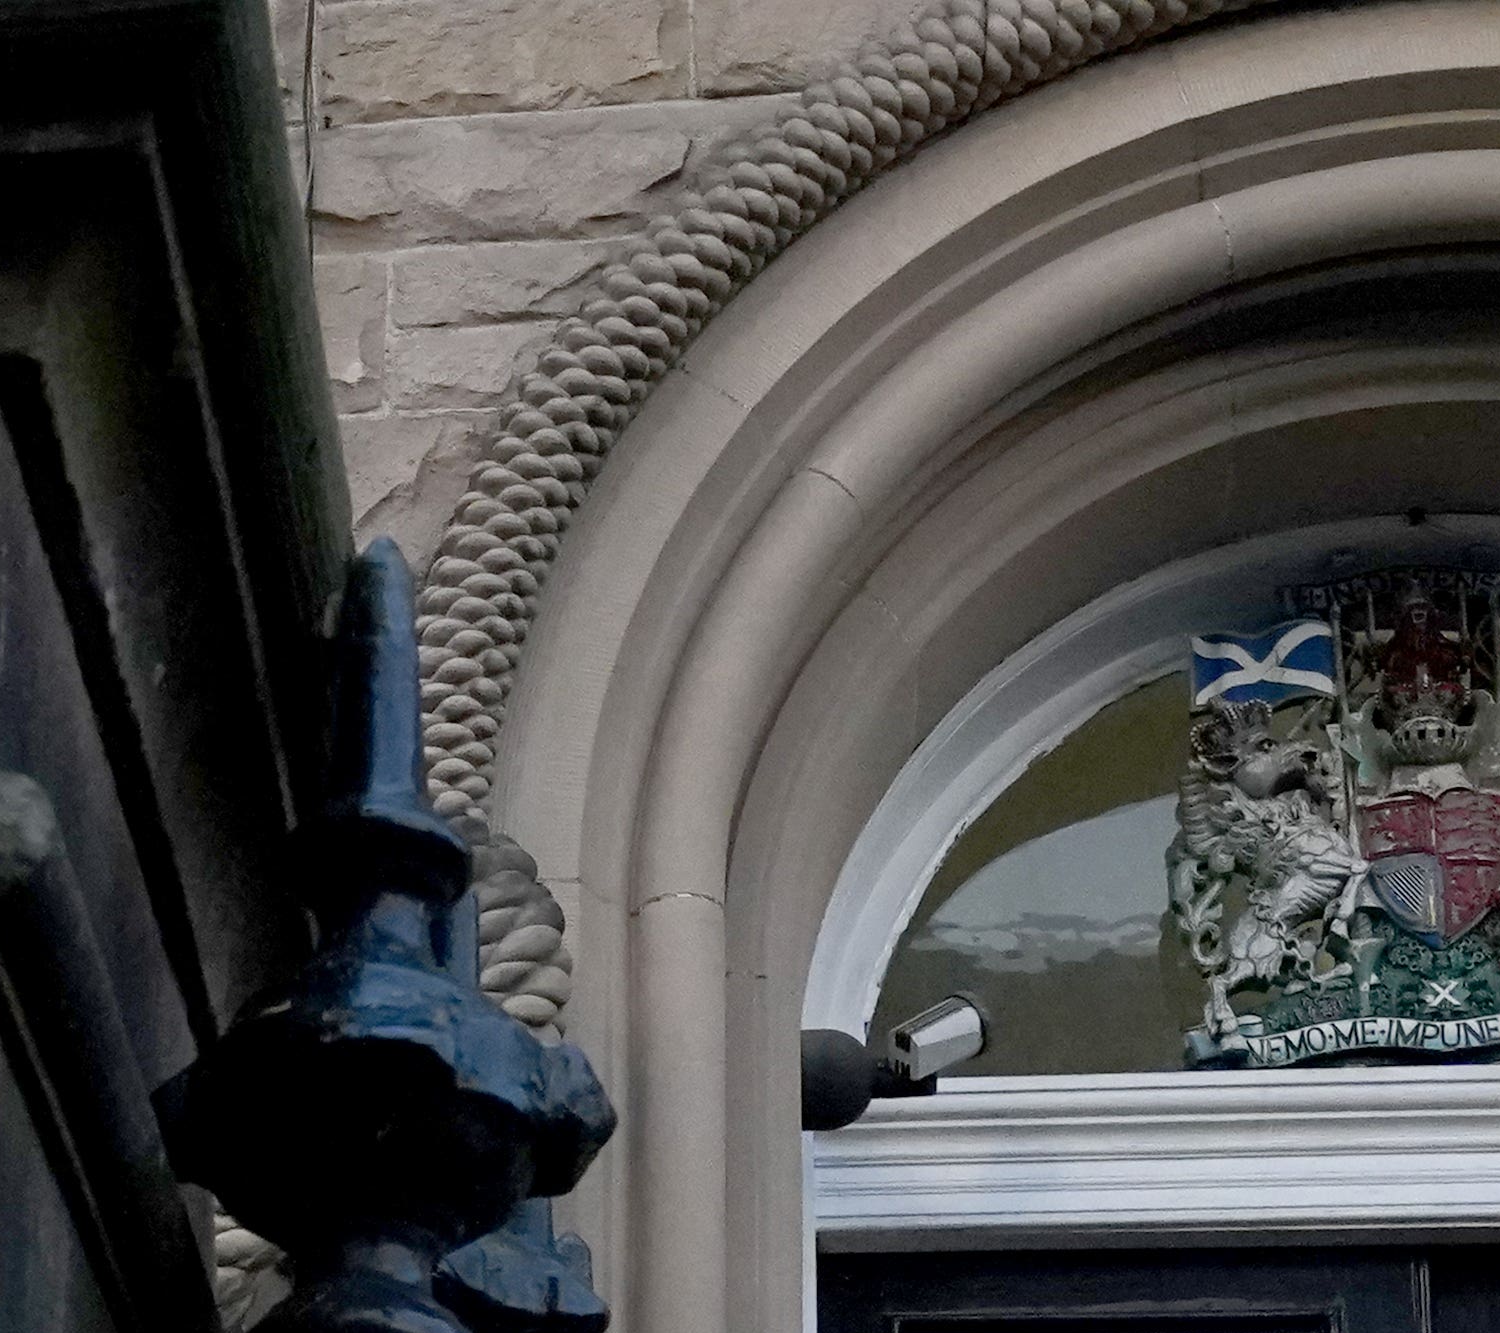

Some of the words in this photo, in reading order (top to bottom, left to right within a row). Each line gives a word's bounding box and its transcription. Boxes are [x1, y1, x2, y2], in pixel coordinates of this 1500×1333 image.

[1246, 1026, 1327, 1065] NEMO
[1331, 1019, 1379, 1049] ME
[1385, 1017, 1499, 1049] IMPUNE
